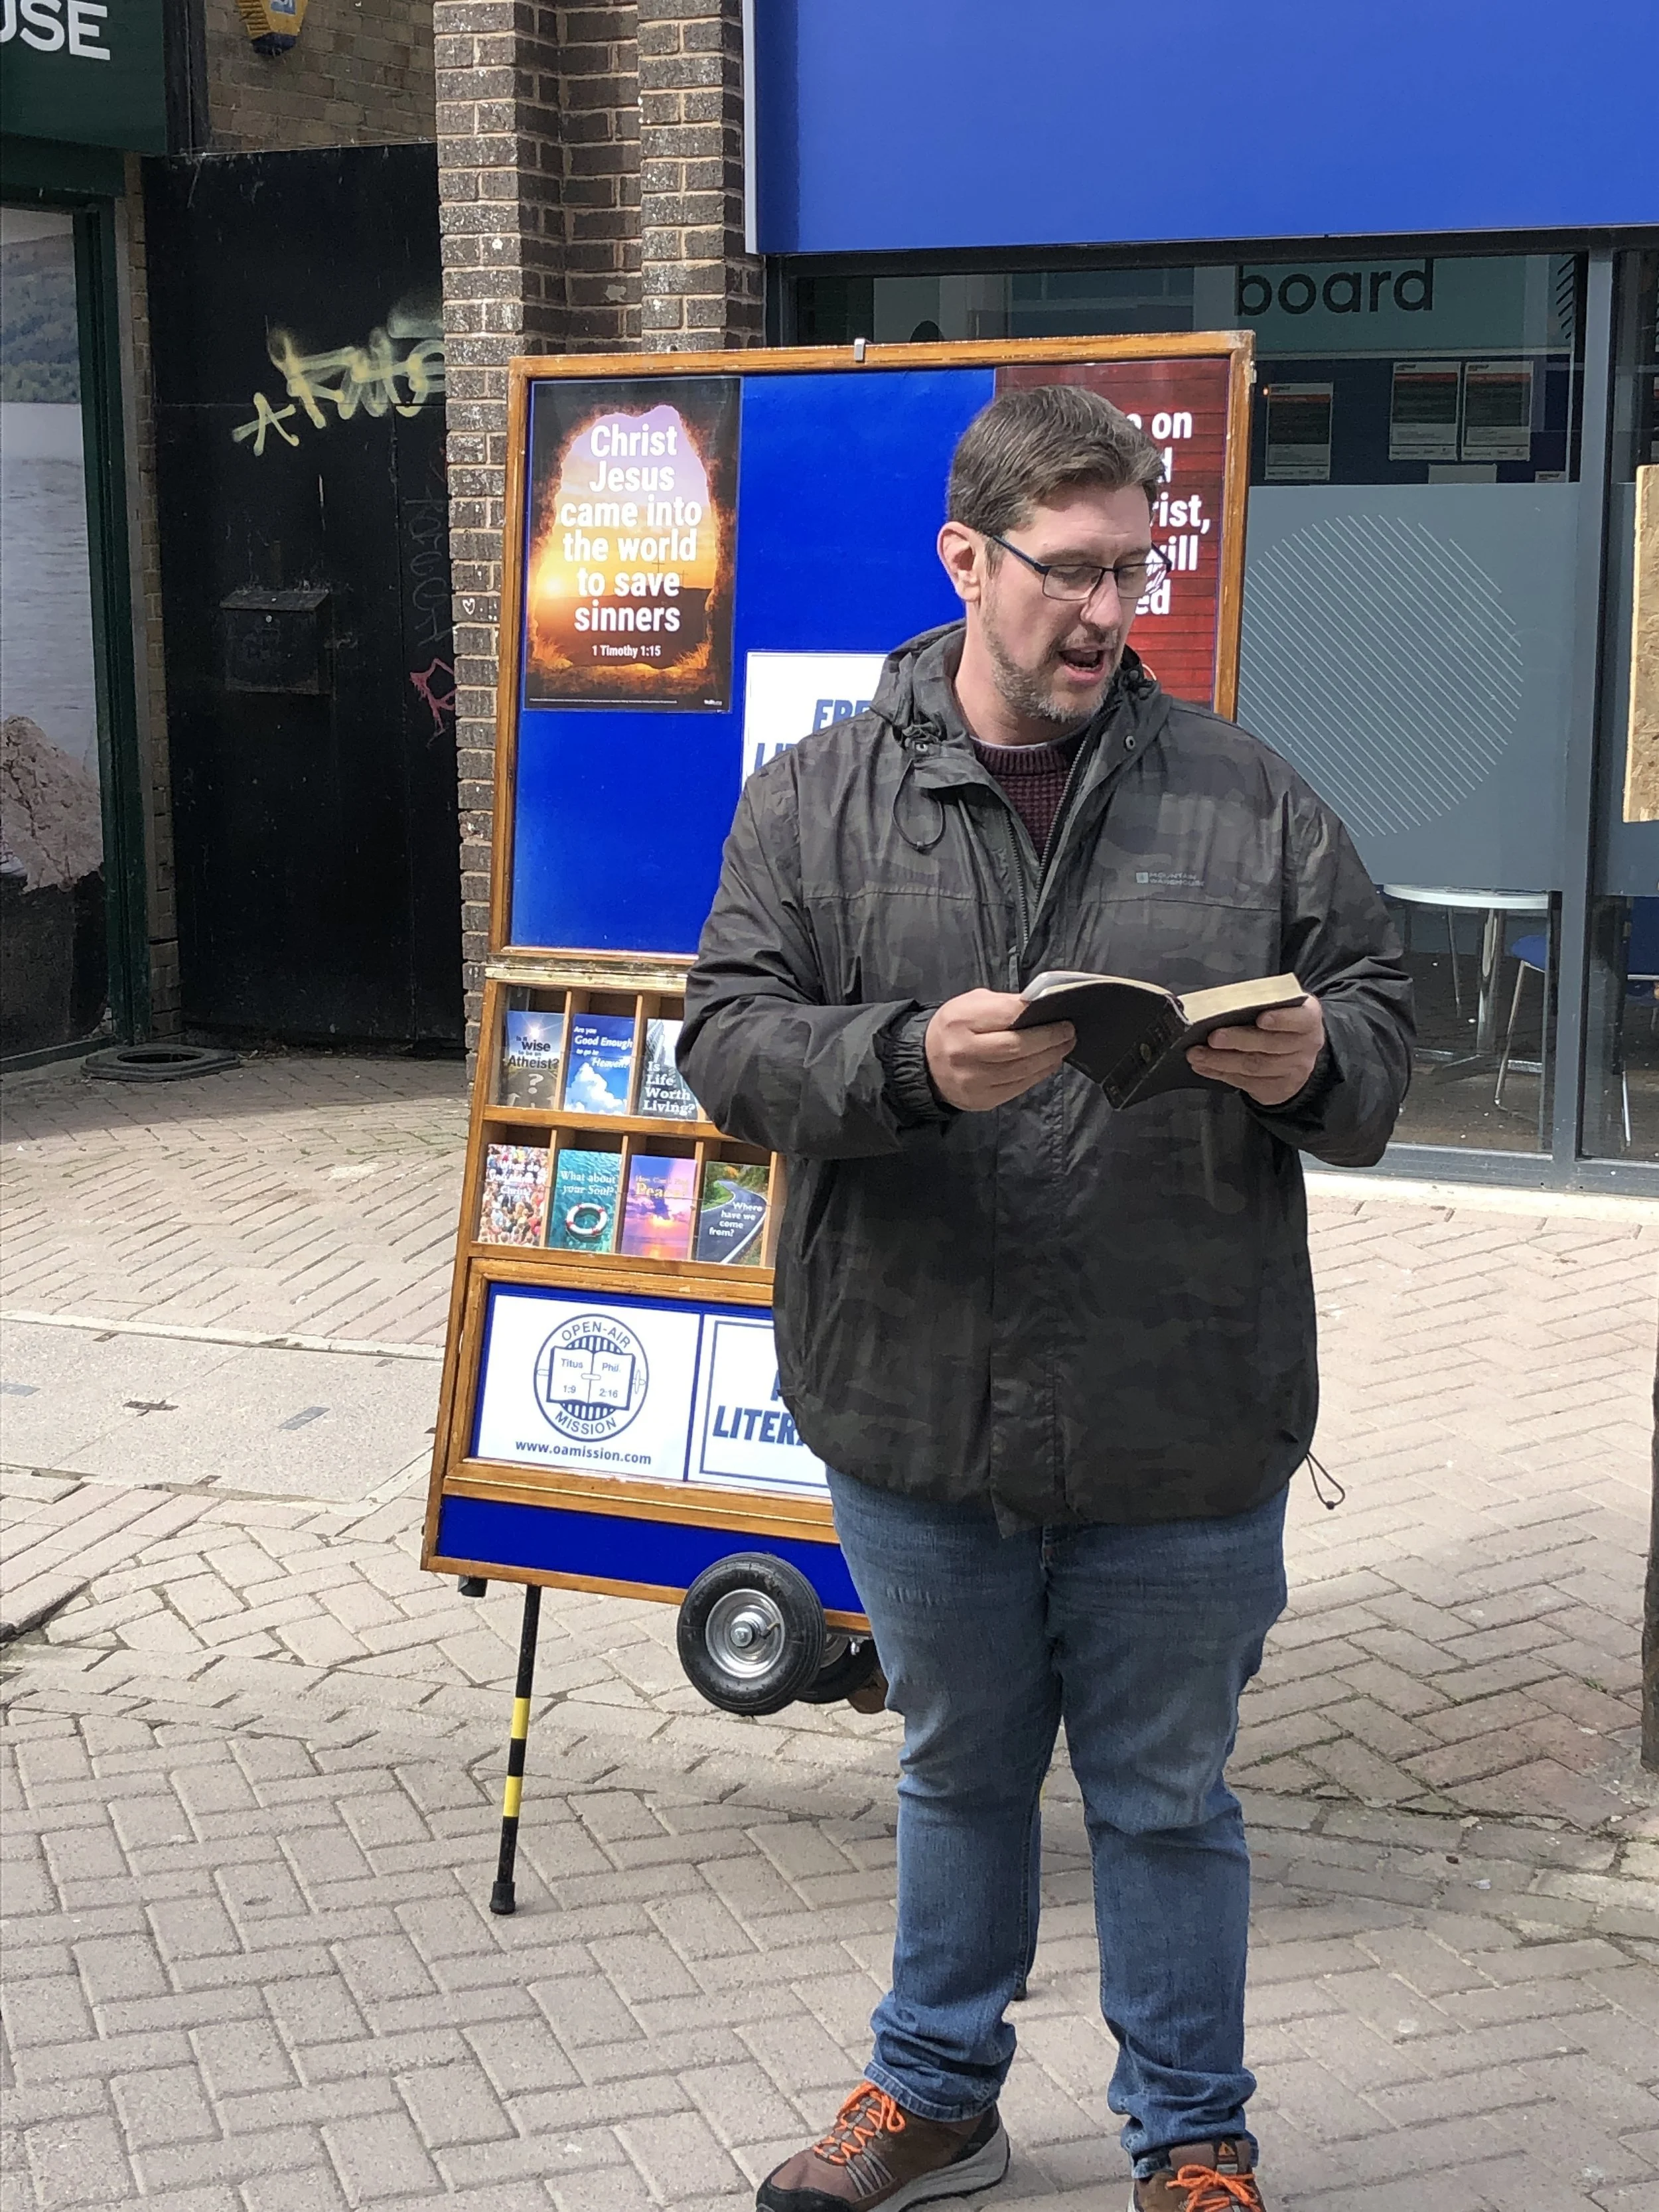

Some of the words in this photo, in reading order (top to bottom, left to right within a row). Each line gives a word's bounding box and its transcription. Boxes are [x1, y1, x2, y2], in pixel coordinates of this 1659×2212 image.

[1238, 257, 1434, 315] board
[1151, 411, 1192, 439] on
[591, 423, 678, 457] Christ
[589, 460, 675, 492] Jesus
[561, 502, 638, 527] came
[646, 493, 702, 526] into
[563, 529, 609, 562] the
[617, 528, 697, 562] world
[577, 567, 606, 597] to
[613, 571, 681, 597] save
[573, 599, 681, 632] sinners
[592, 644, 597, 656] 1
[599, 644, 638, 659] Timothy
[640, 644, 662, 657] 1:15
[522, 1039, 551, 1052] wise
[575, 1035, 599, 1046] Good
[600, 1037, 634, 1051] Enough
[508, 1055, 560, 1069] Atheist?
[647, 1061, 661, 1072] Is
[646, 1073, 674, 1086] Life
[645, 1086, 691, 1101] Worth
[642, 1099, 695, 1116] Living?
[560, 1170, 586, 1181] What
[587, 1173, 616, 1184] about
[561, 1185, 585, 1195] your
[733, 1201, 763, 1212] Where
[721, 1209, 742, 1220] have
[709, 1226, 735, 1237] from?
[719, 1220, 744, 1229] come
[561, 1321, 630, 1349] OPEN-AIR
[561, 1358, 583, 1368] Titus
[602, 1363, 621, 1372] Phil.
[555, 1410, 617, 1436] MISSION
[713, 1405, 804, 1446] LITER
[515, 1441, 652, 1465] www.oamission.com
